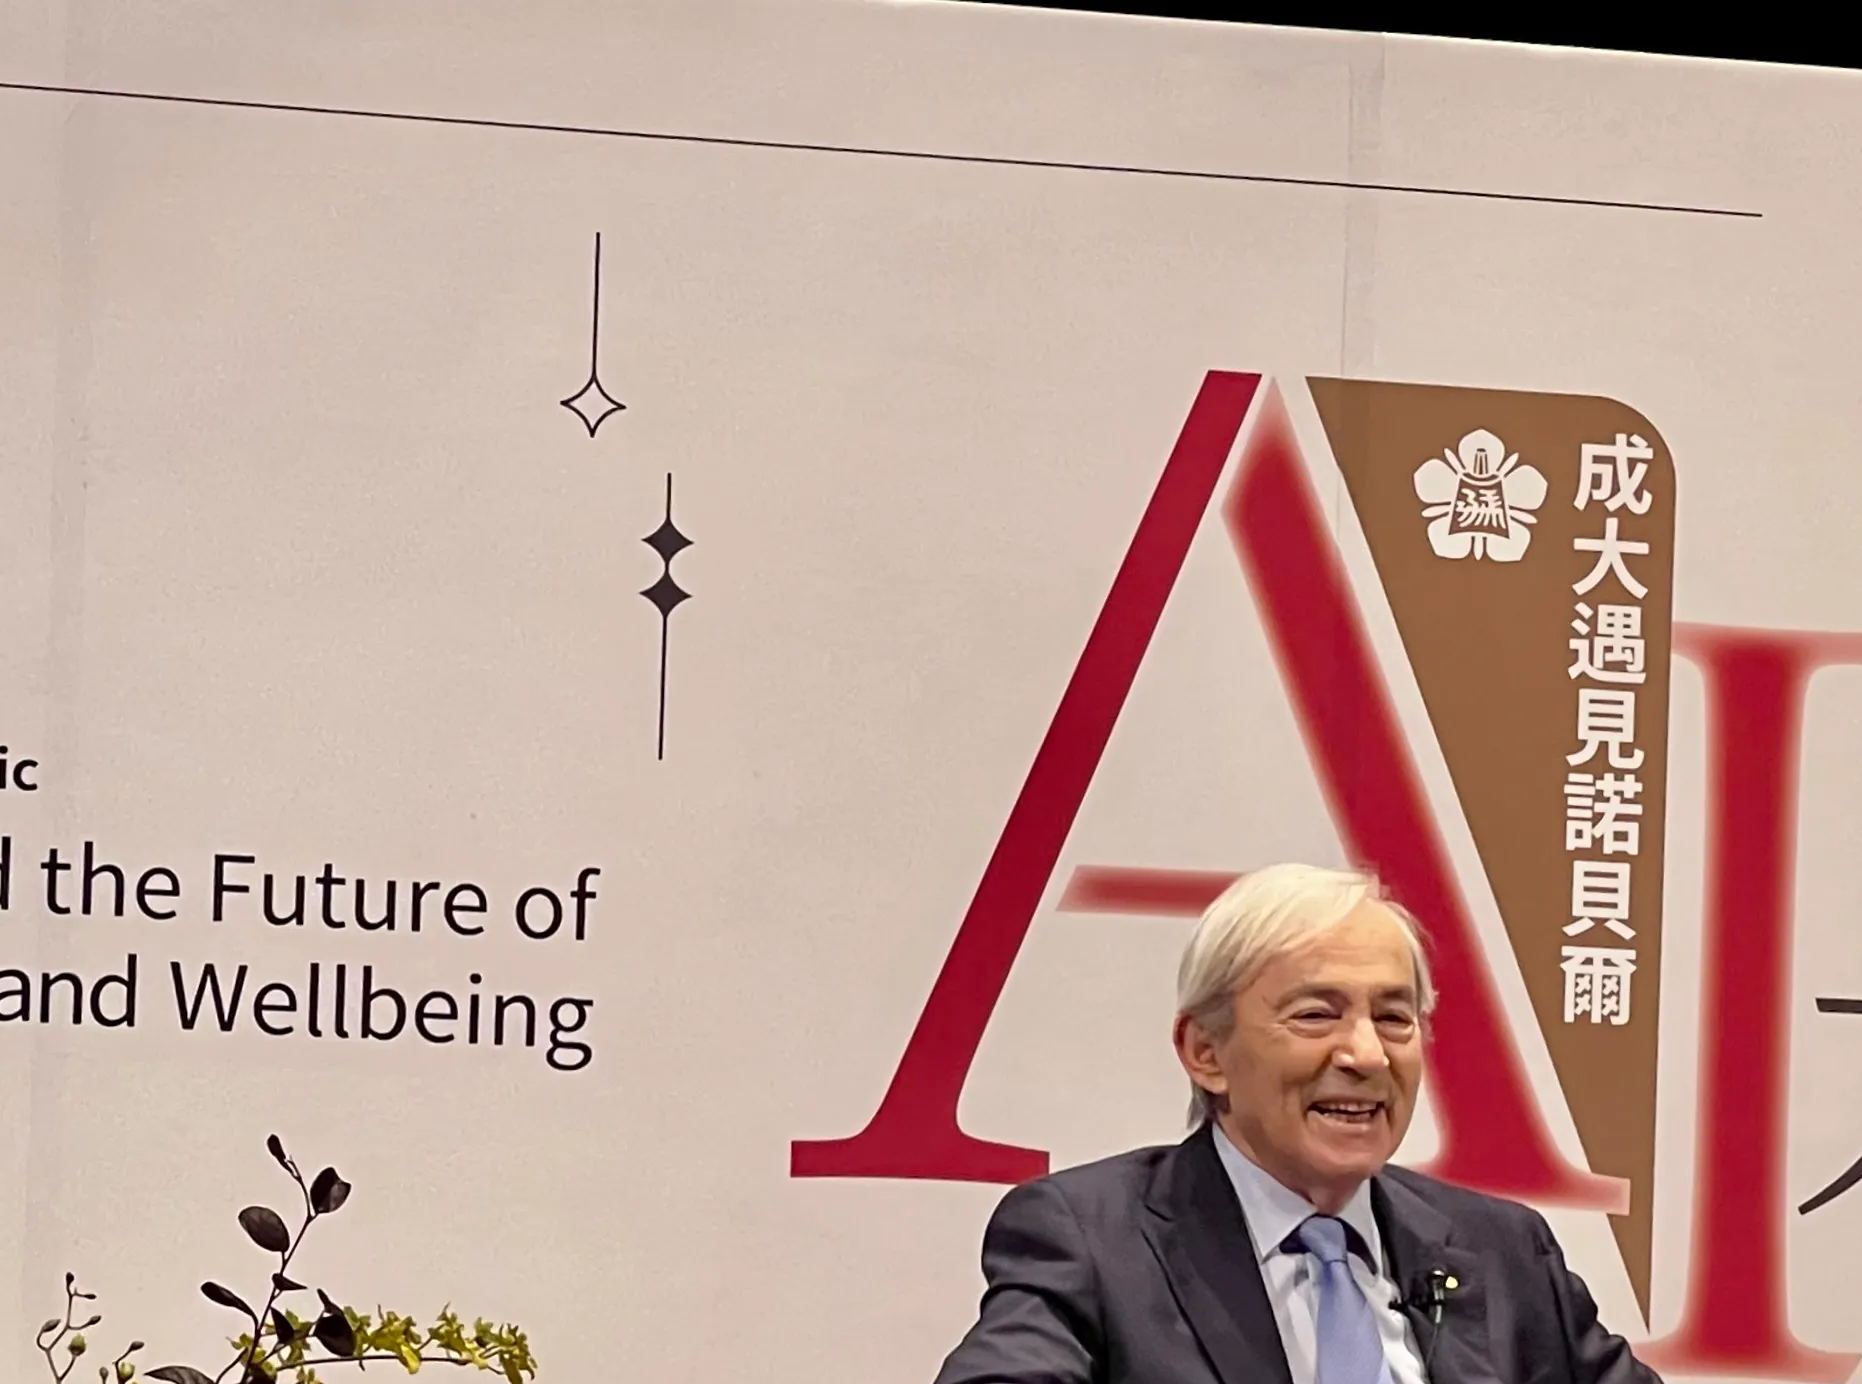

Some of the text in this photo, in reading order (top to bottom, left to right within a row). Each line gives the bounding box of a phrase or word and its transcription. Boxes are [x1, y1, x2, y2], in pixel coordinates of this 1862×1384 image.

[1561, 432, 1654, 1027] 成大遇見諾貝爾
[40, 841, 180, 920] the
[213, 854, 487, 936] Future
[516, 868, 601, 940] of
[0, 953, 593, 1071] and Wellbeing
